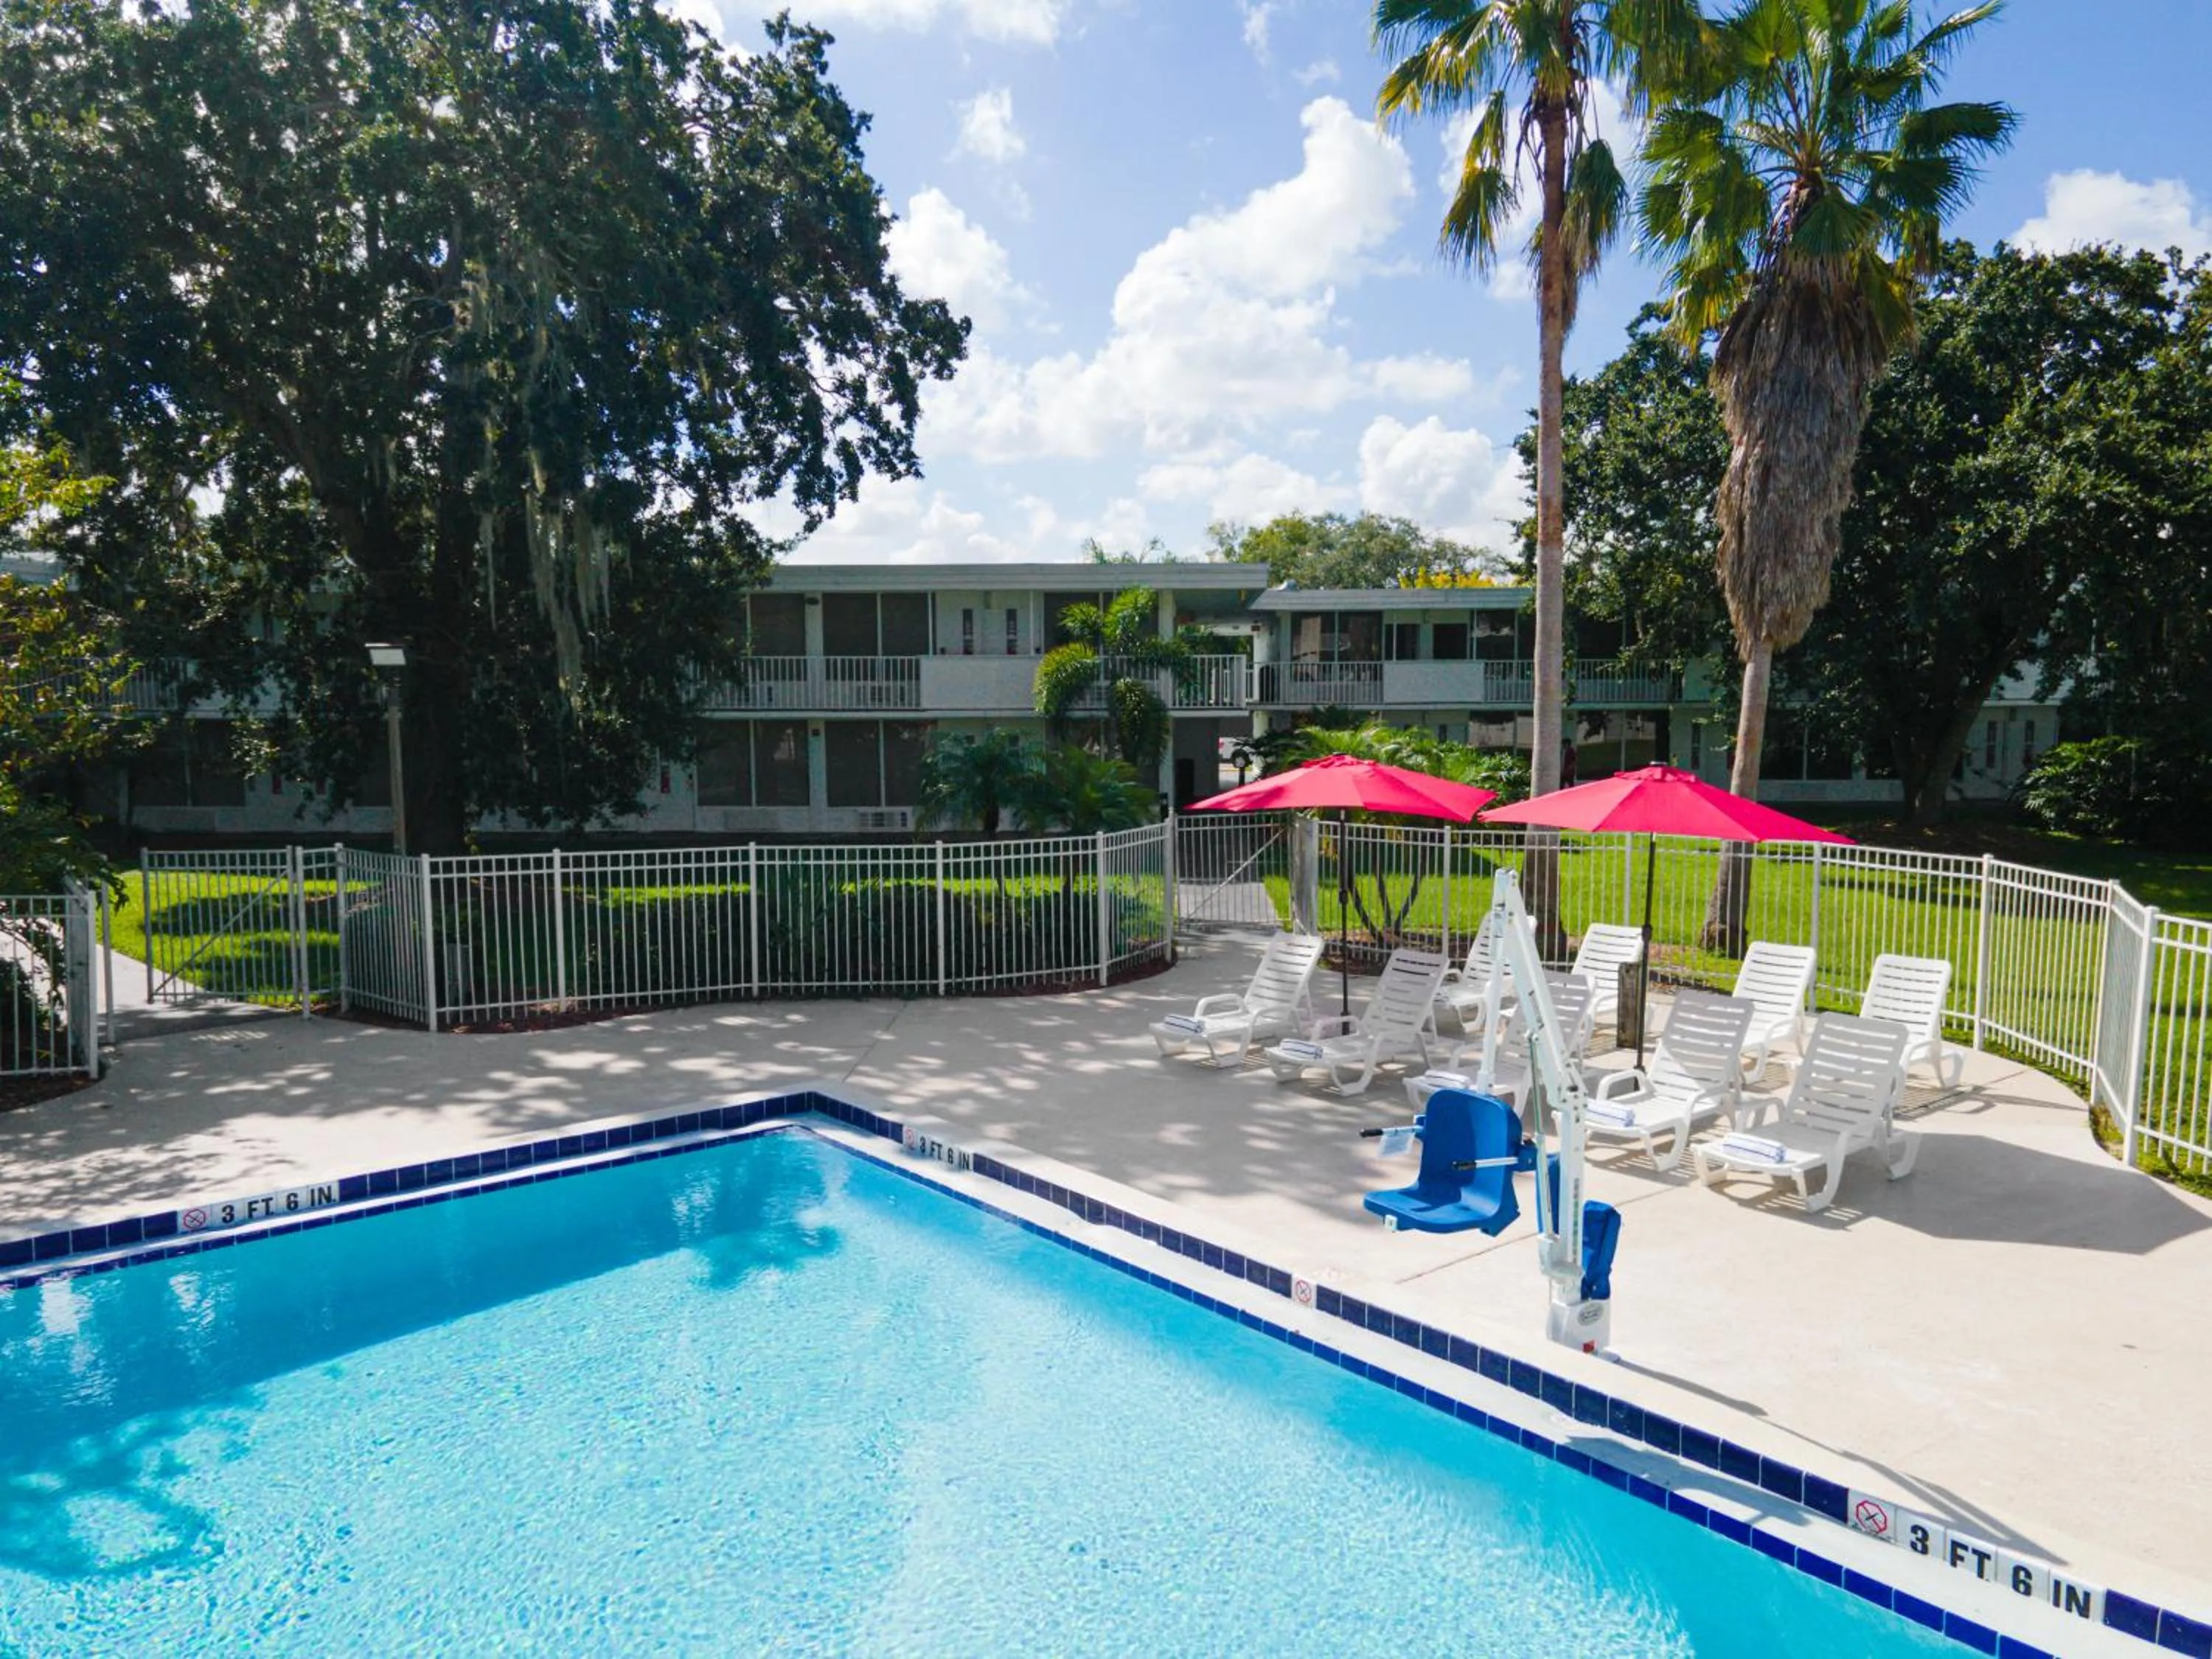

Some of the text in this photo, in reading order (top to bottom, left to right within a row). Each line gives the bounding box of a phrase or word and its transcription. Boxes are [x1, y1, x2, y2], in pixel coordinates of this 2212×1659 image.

[222, 1204, 234, 1224] 3
[286, 1192, 299, 1211] 6
[1910, 1524, 1930, 1555] 3
[2012, 1565, 2033, 1597] 6
[2053, 1579, 2090, 1619] IN
